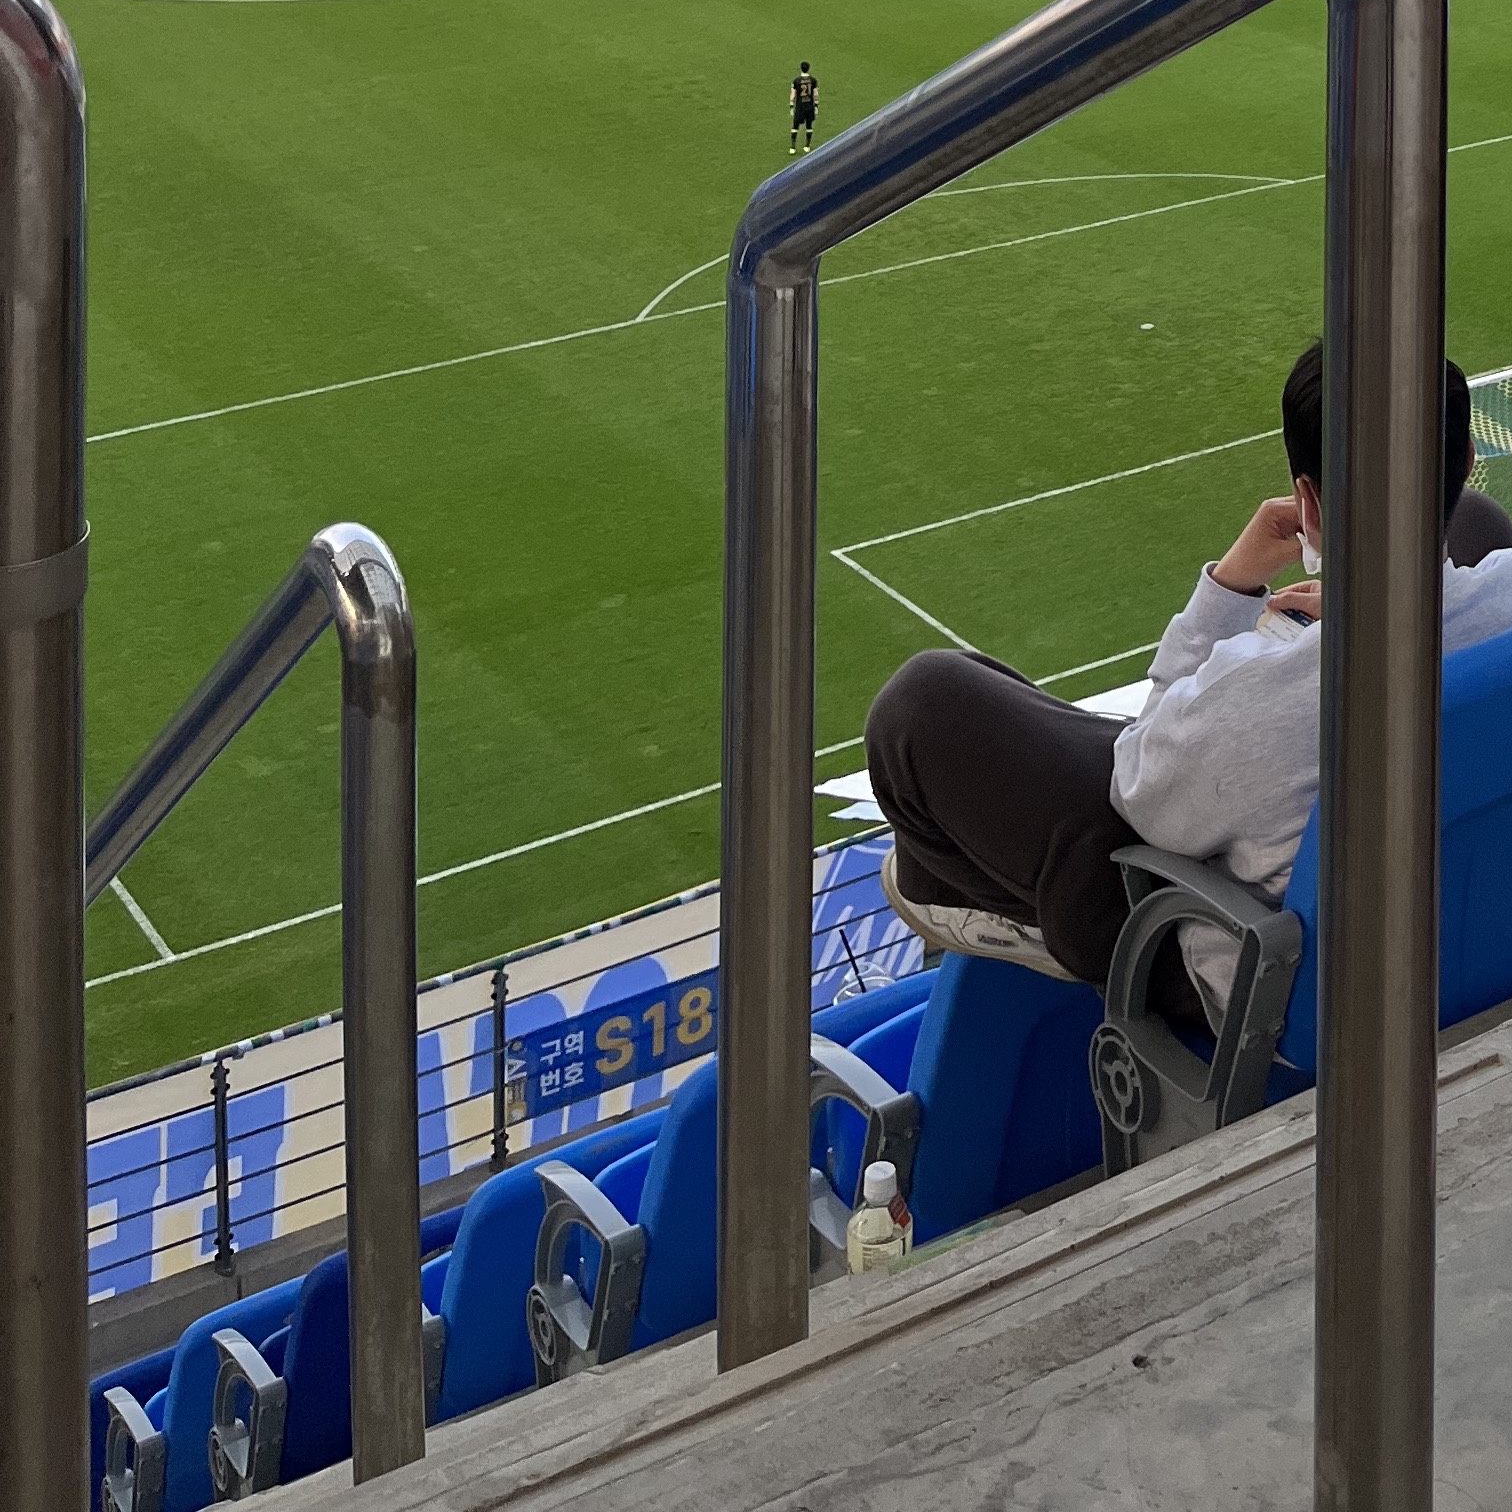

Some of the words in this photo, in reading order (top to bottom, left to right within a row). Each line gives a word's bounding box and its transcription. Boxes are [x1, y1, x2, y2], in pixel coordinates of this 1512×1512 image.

[800, 84, 812, 97] 21
[540, 1029, 584, 1067] 구역
[594, 986, 713, 1075] S18
[540, 1061, 584, 1098] 번호
